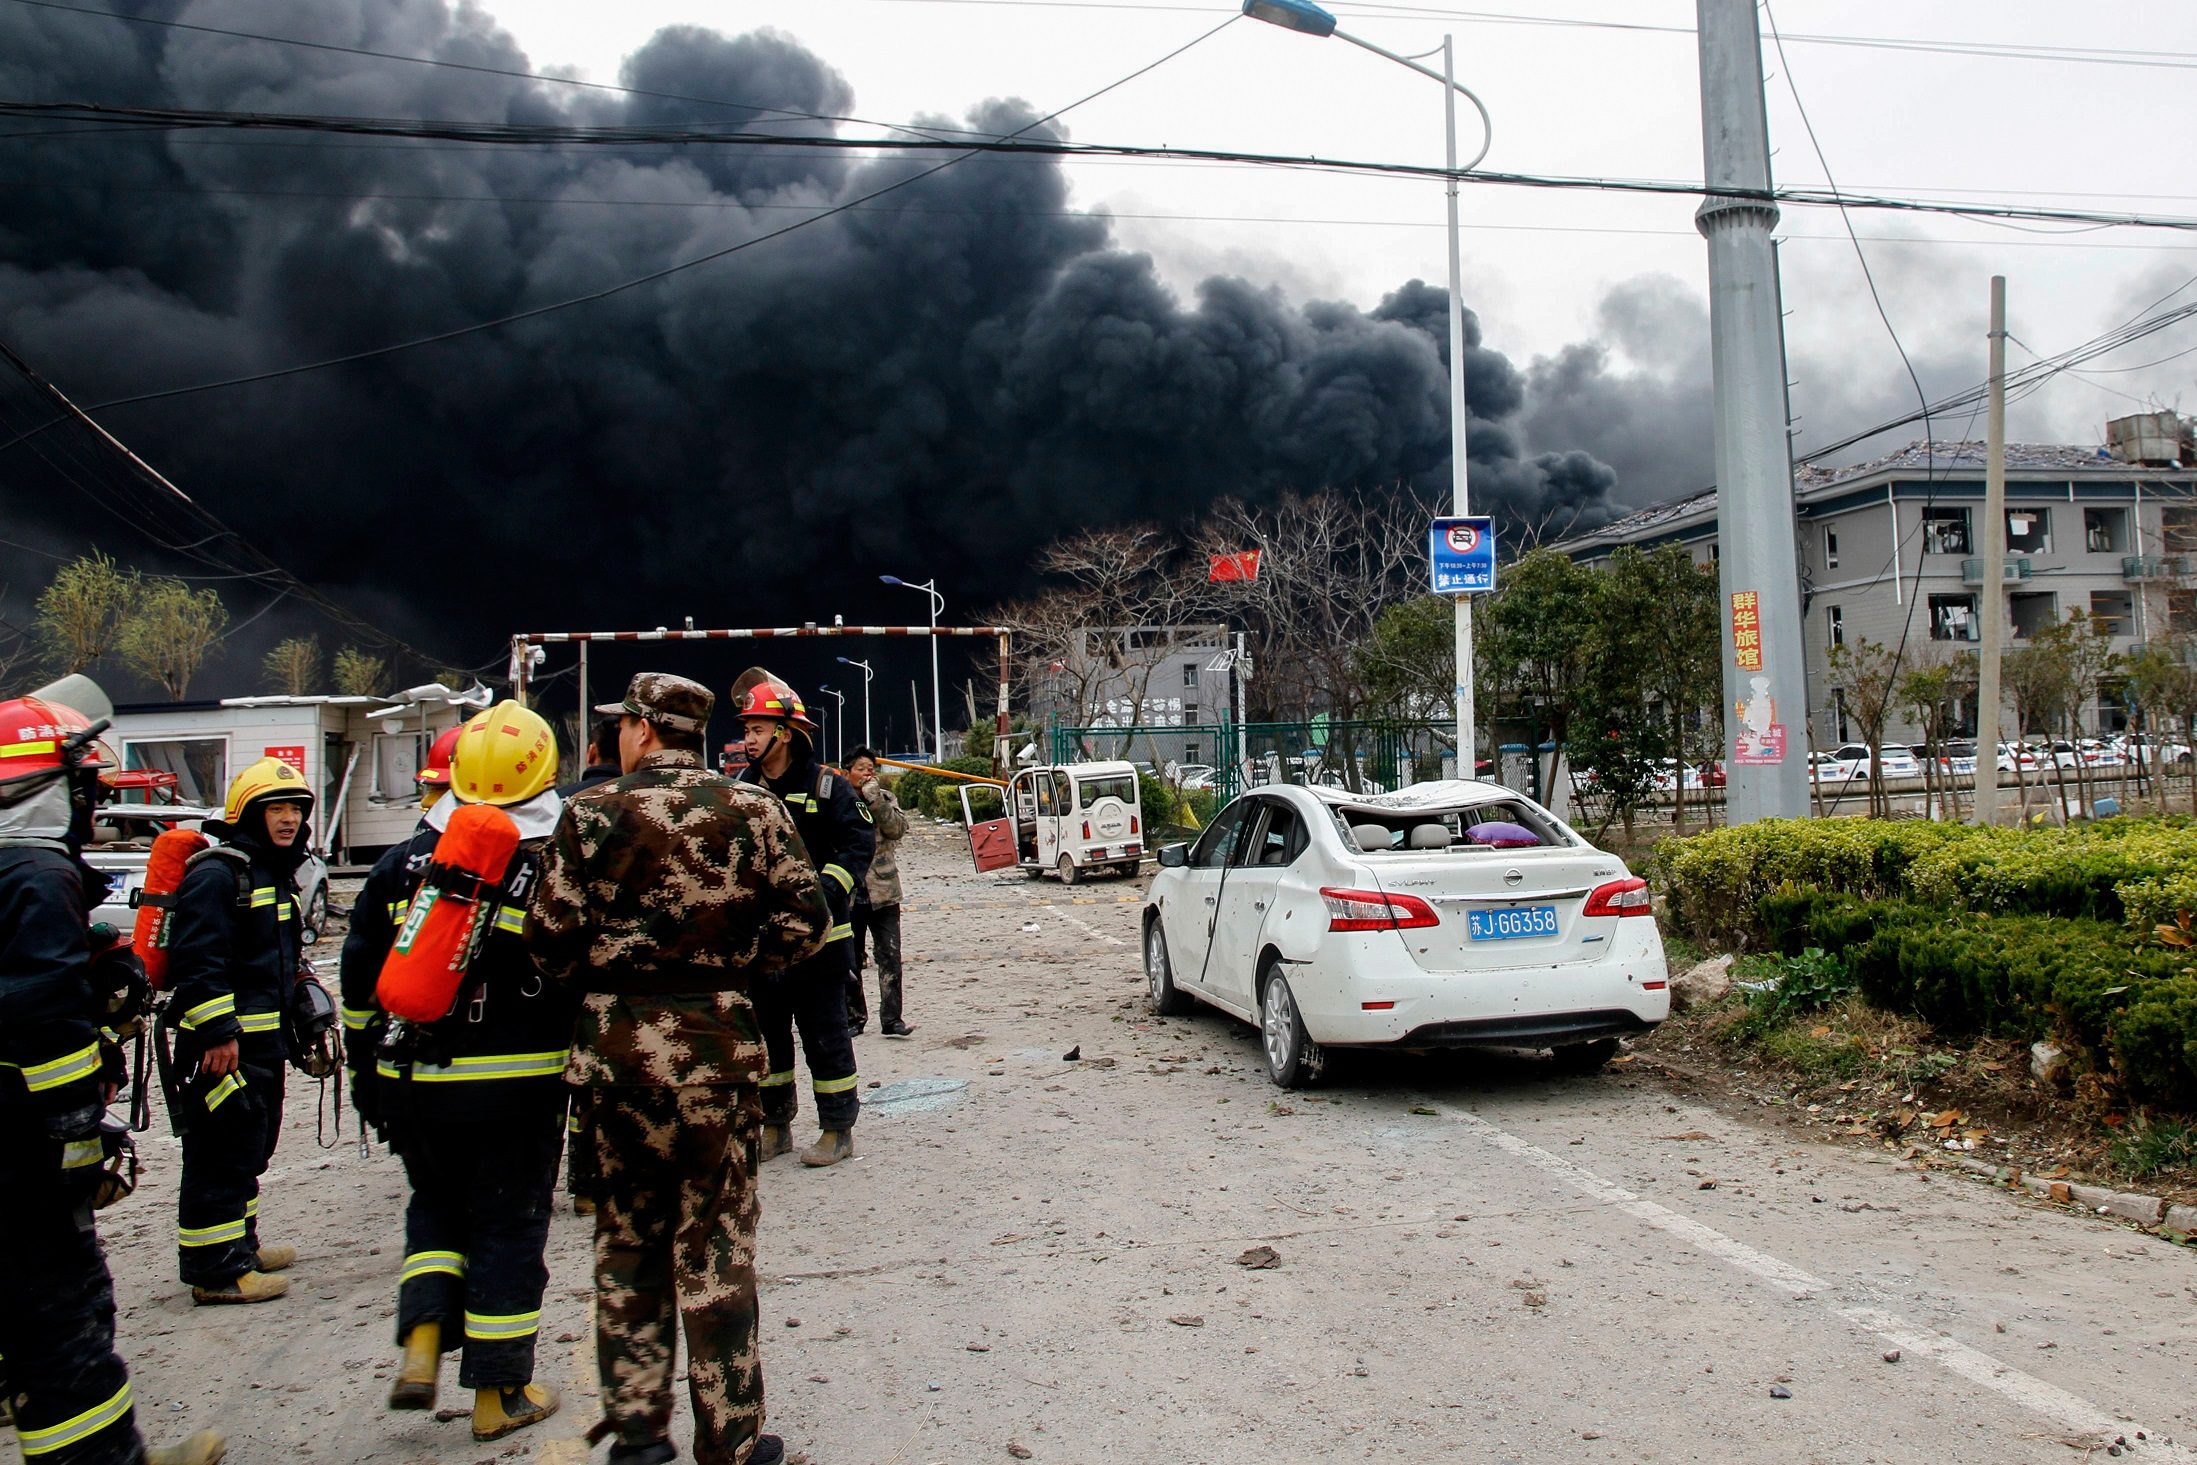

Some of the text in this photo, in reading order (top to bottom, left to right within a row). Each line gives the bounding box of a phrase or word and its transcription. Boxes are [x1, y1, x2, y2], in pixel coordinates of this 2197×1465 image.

[1438, 573, 1489, 587] 禁止通行
[1733, 592, 1759, 666] 群华旅馆
